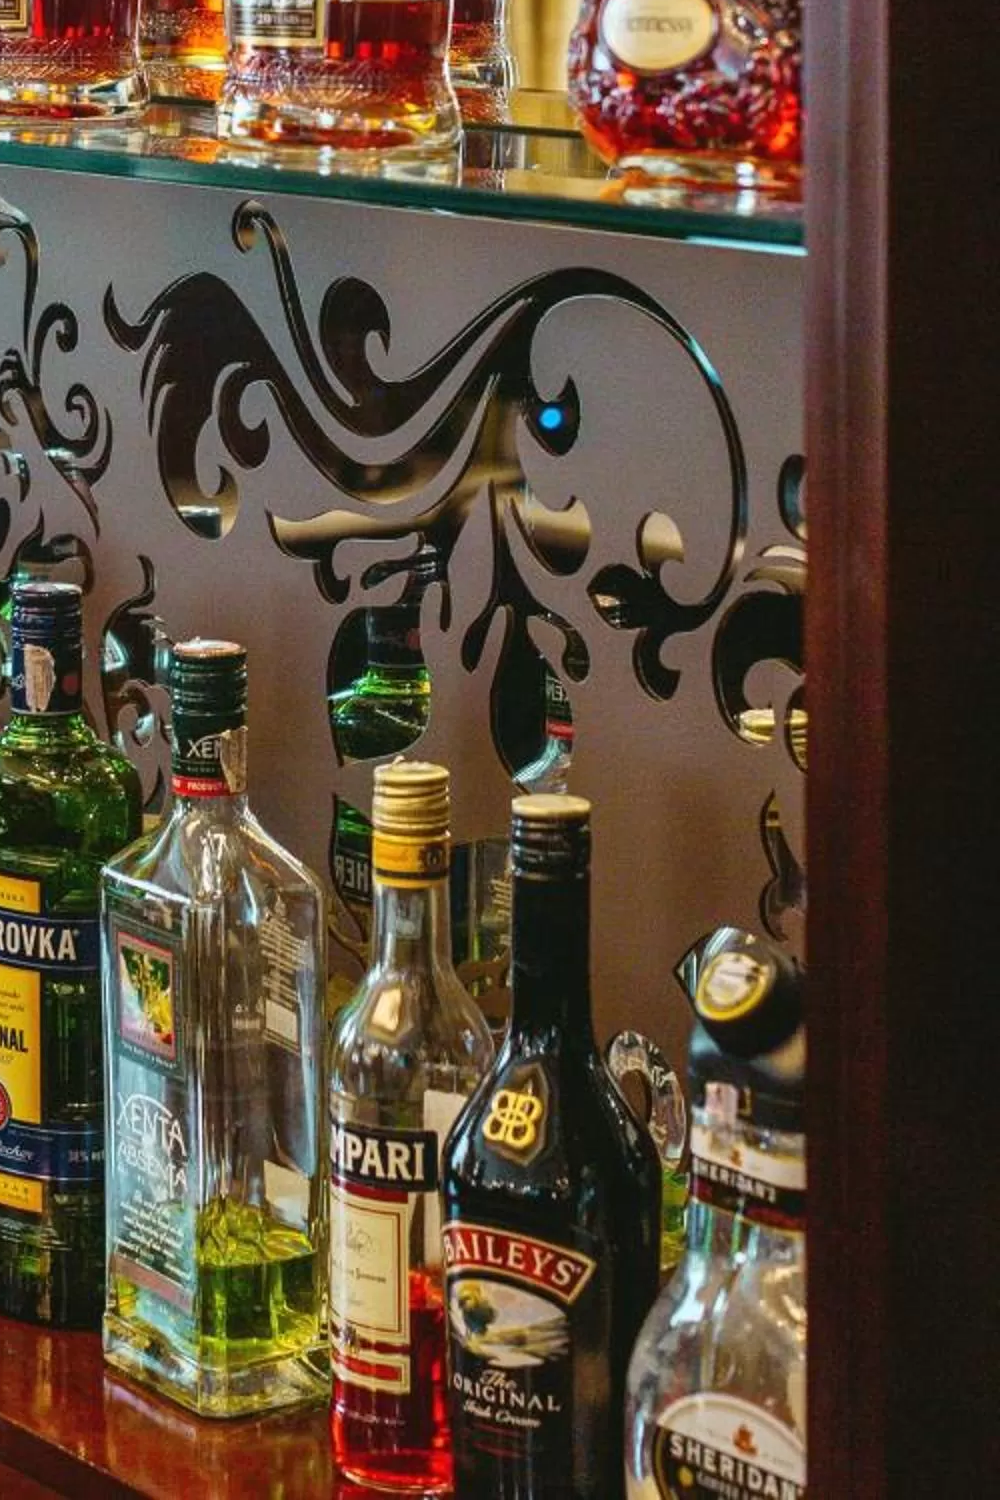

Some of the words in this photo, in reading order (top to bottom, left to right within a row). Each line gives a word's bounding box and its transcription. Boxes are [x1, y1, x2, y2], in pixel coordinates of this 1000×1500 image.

[116, 1091, 188, 1157] XENTA
[445, 1232, 575, 1288] BAILEYS
[453, 1371, 561, 1413] ORIGINAL
[479, 1368, 517, 1391] The
